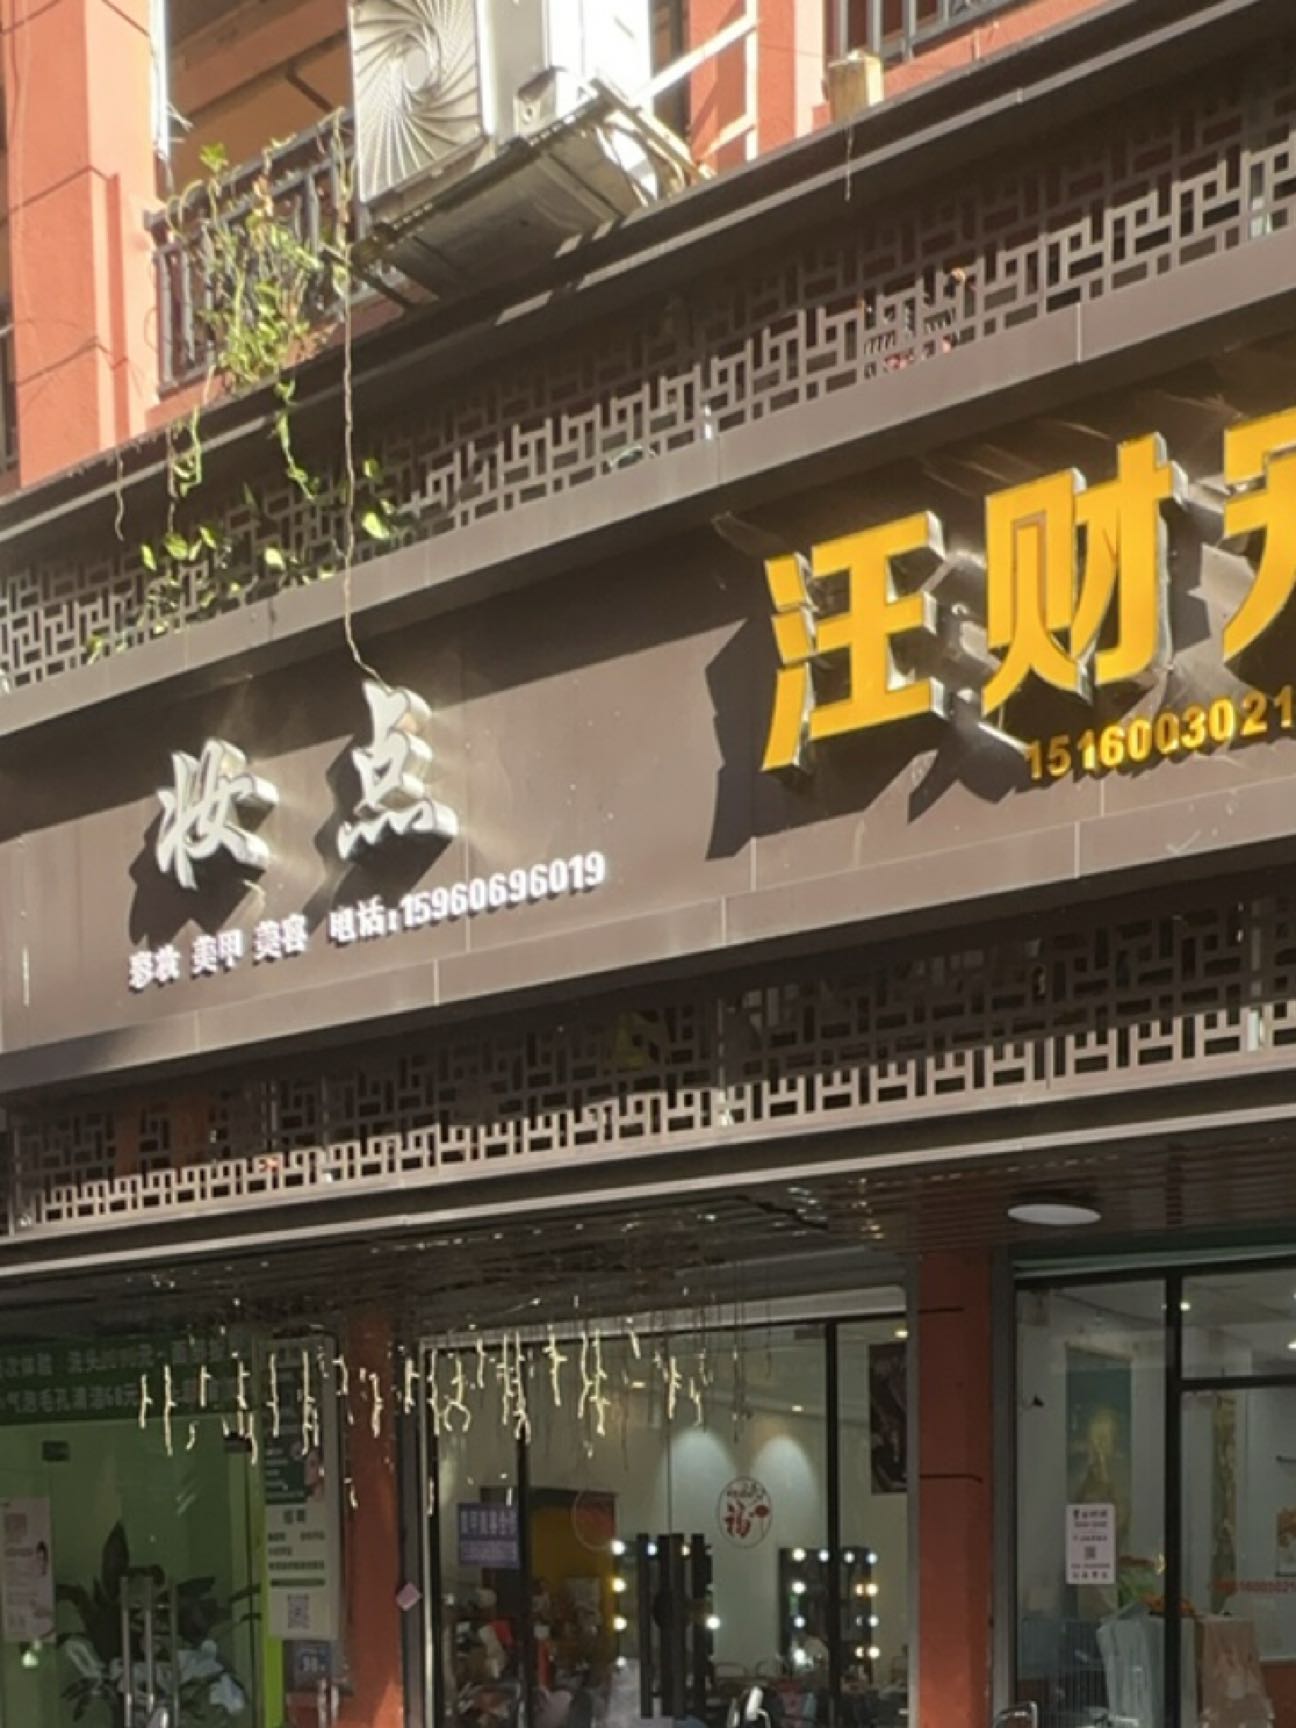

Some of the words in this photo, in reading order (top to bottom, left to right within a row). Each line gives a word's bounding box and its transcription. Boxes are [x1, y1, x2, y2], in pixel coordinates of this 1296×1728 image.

[156, 678, 460, 890] 妆点
[191, 927, 243, 975] 美甲
[253, 913, 308, 961] 美容
